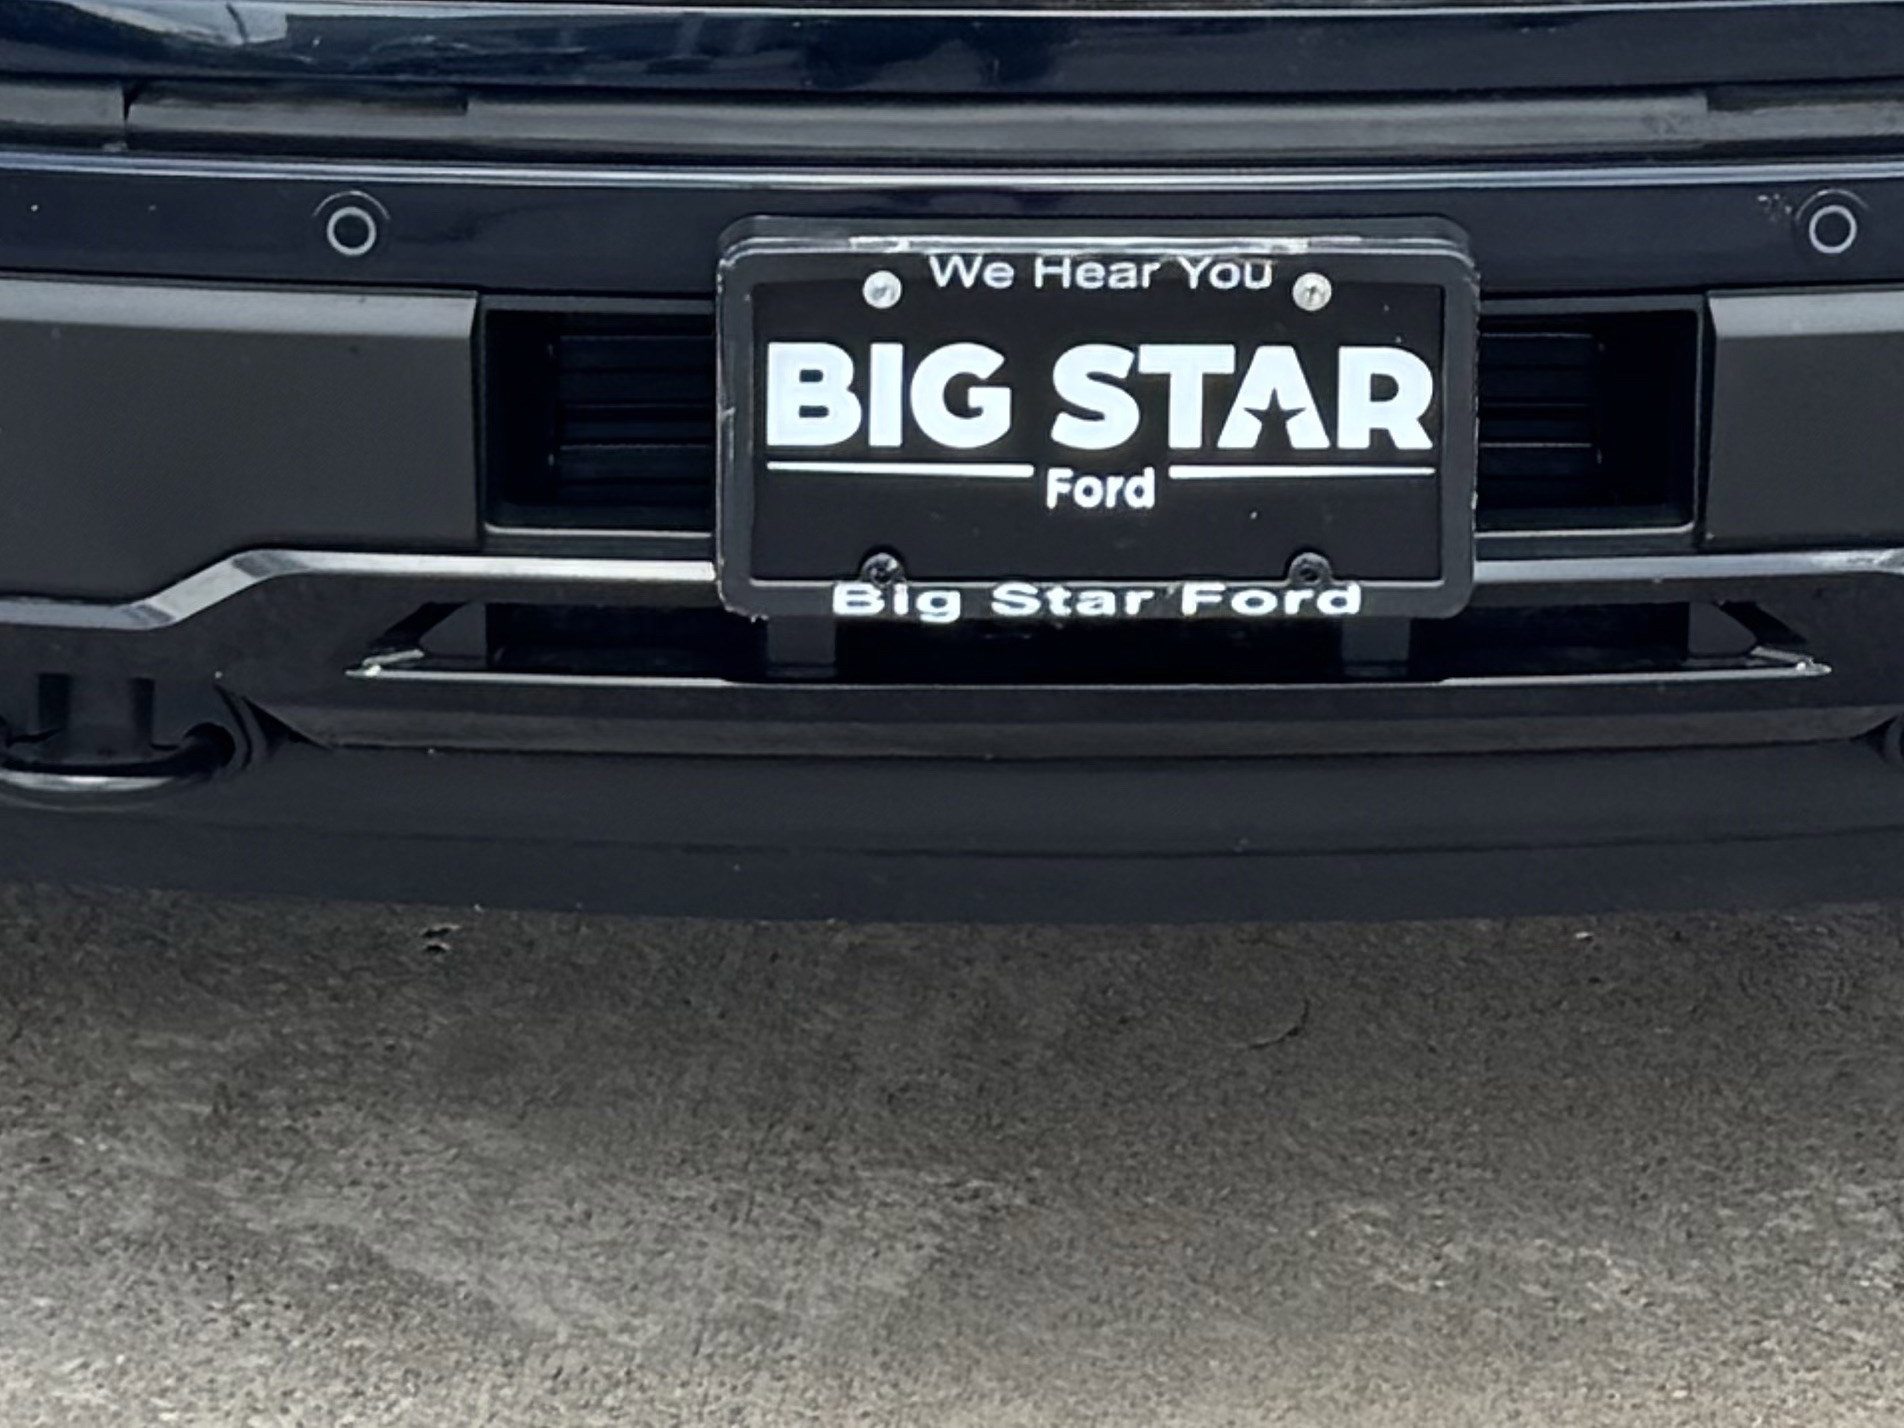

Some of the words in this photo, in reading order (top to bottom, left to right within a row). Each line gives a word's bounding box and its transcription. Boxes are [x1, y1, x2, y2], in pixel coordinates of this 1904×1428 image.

[929, 254, 1015, 288] We
[1034, 256, 1161, 289] Hear
[1175, 255, 1273, 290] You
[766, 342, 1012, 449] BIG
[1050, 343, 1434, 450] STAR
[1046, 466, 1156, 510] Ford
[832, 582, 962, 623] Big
[991, 582, 1154, 617] Star
[1181, 581, 1362, 617] Ford
